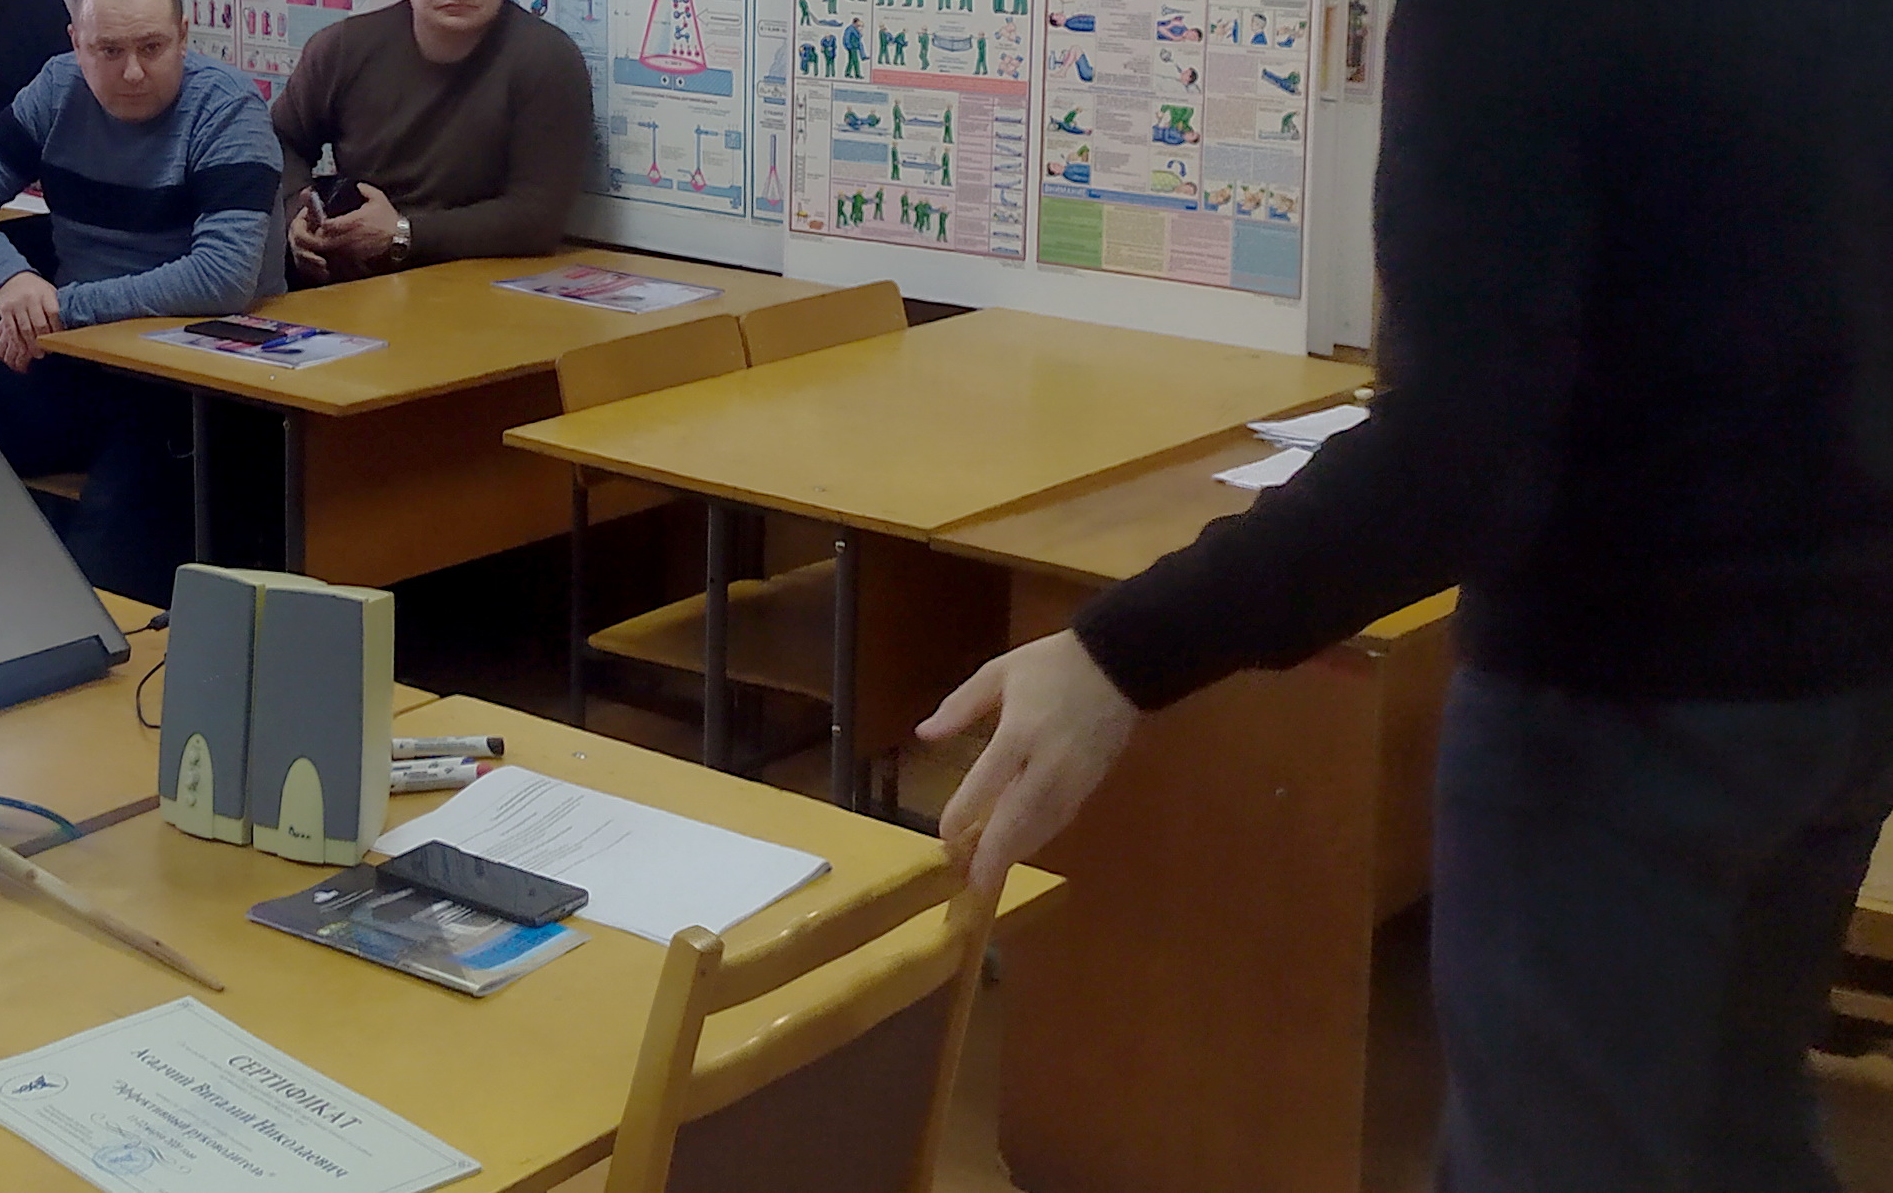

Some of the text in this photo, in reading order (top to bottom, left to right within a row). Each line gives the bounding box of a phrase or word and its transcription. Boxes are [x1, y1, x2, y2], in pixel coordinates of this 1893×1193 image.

[191, 1082, 255, 1124] Виталий
[252, 1118, 349, 1179] Николаевич
[228, 1054, 363, 1130] СЕРТИФИКАТ
